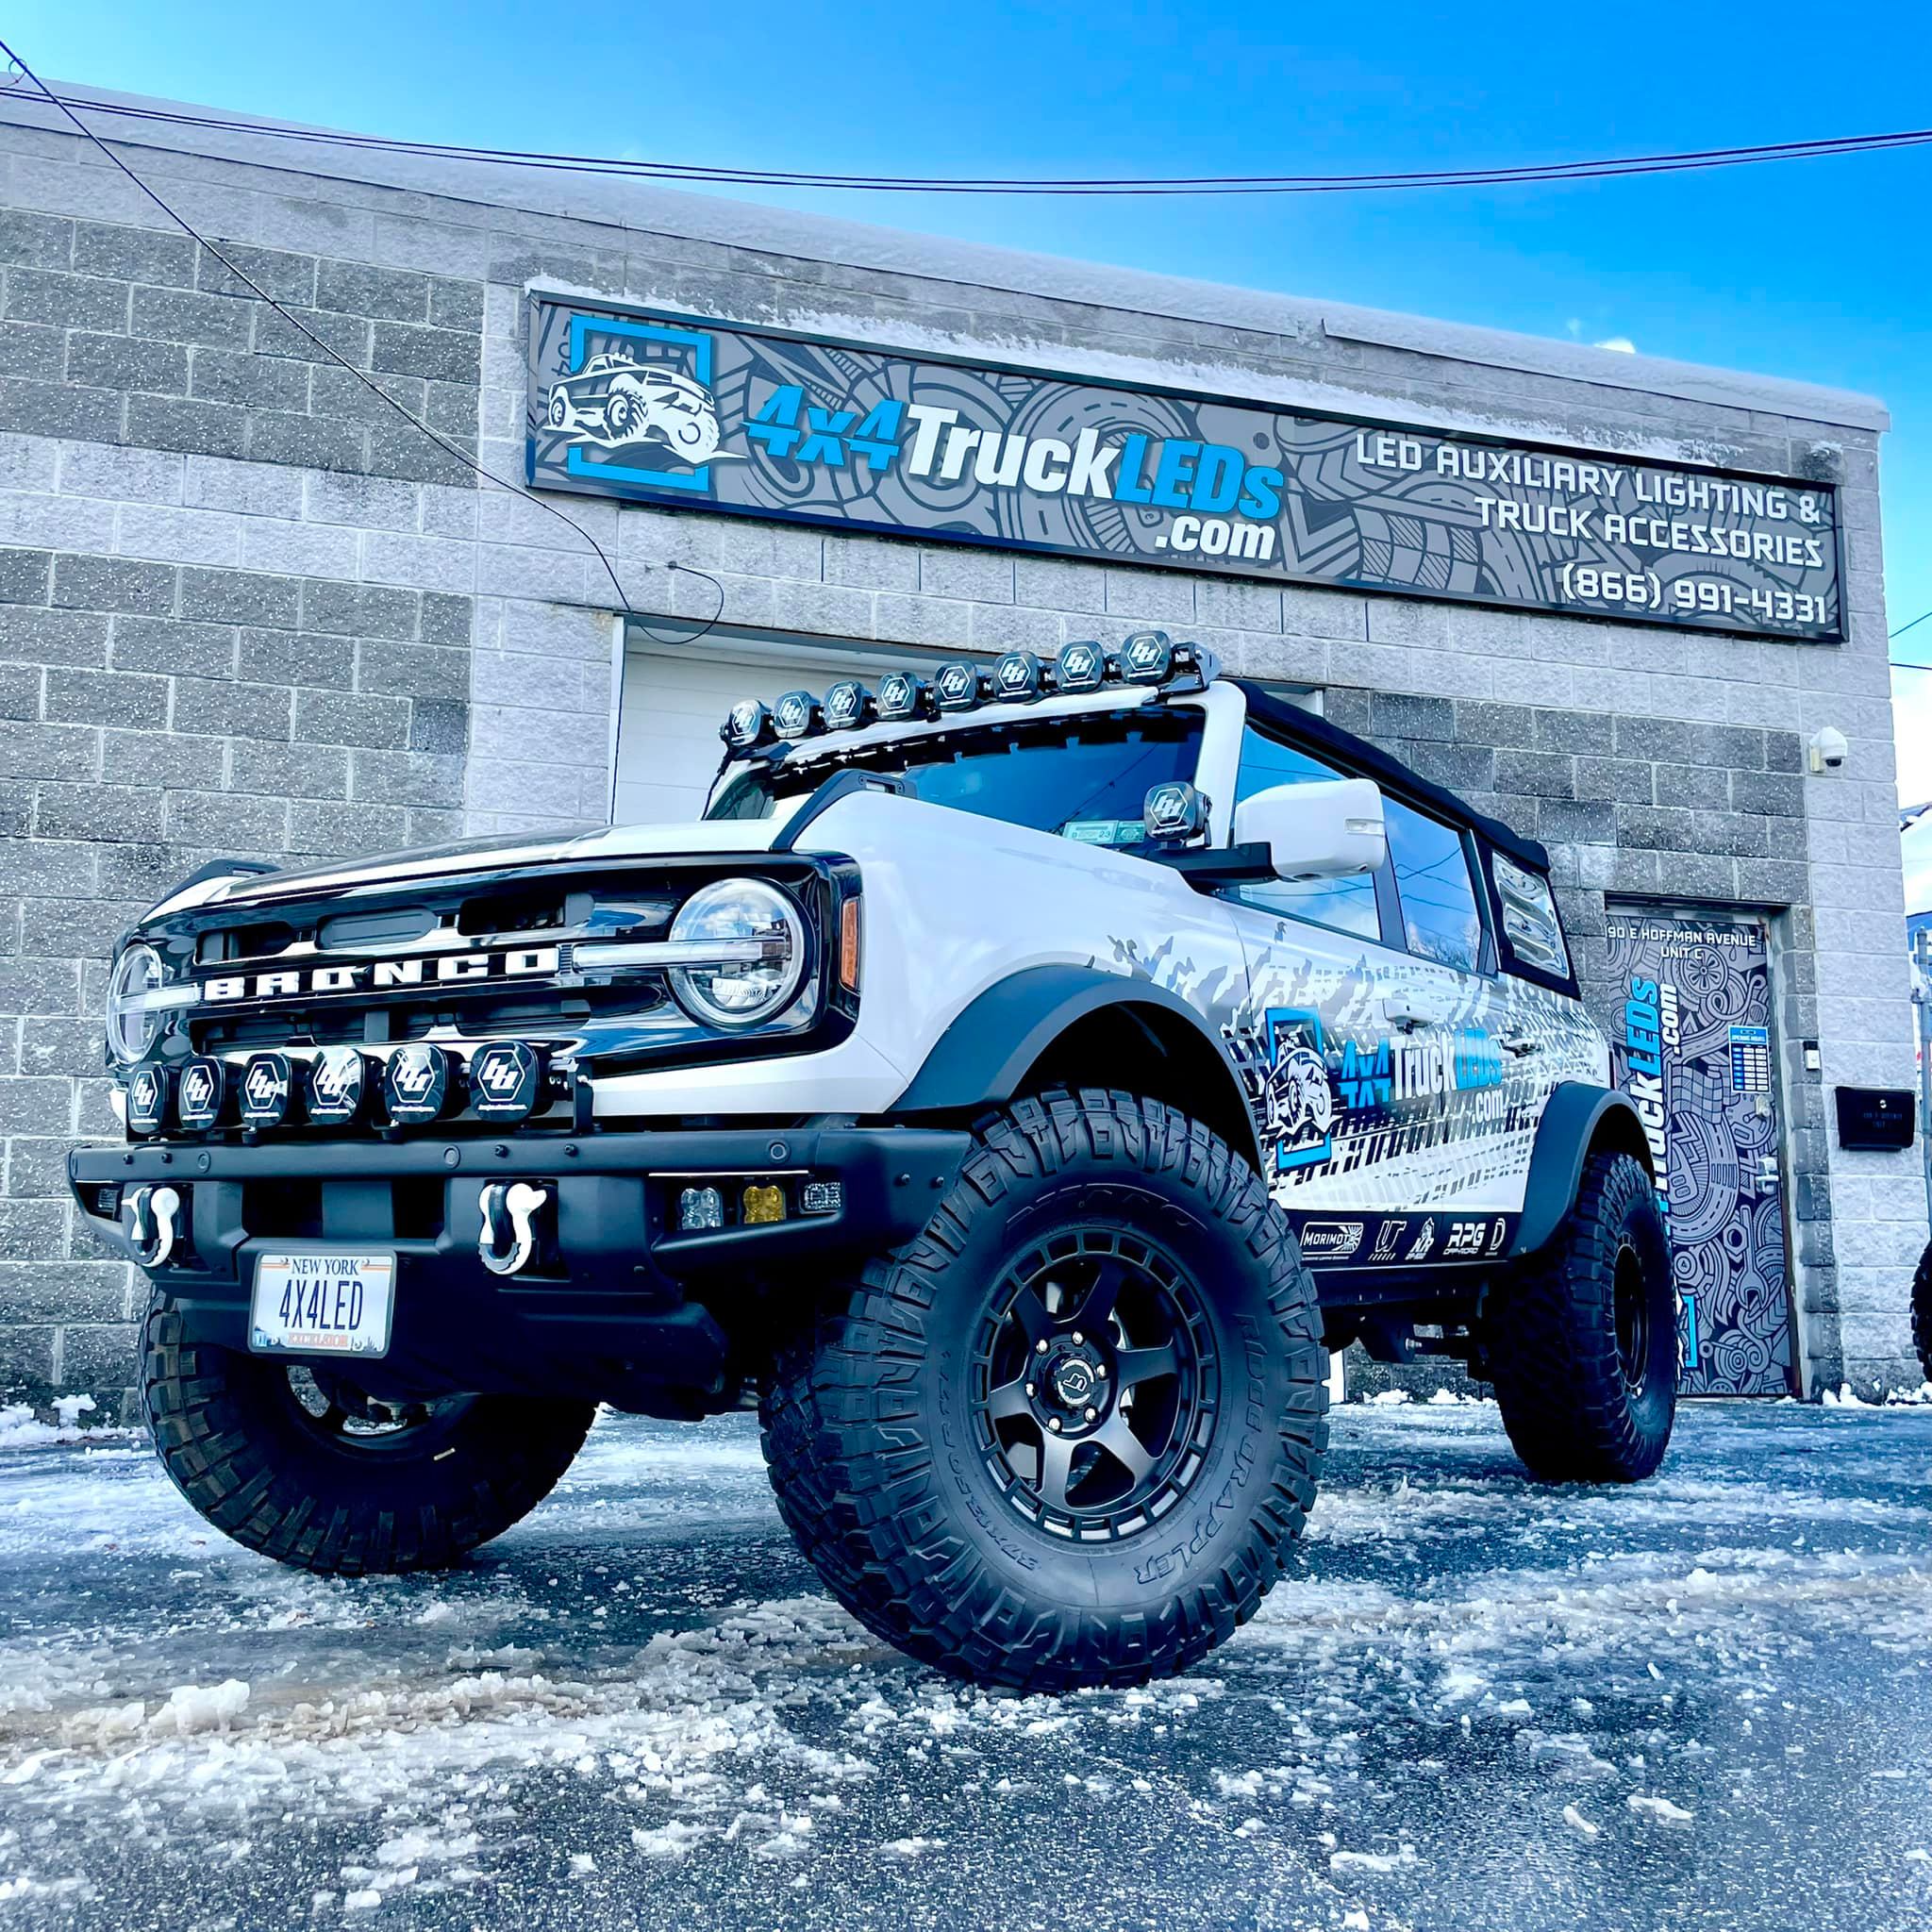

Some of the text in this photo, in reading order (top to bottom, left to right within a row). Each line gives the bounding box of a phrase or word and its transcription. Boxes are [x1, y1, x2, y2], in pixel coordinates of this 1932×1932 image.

[1357, 434, 1822, 525] LED AUXILIARY LIGHTING &
[1154, 514, 1275, 561] .com
[1474, 496, 1824, 568] TRUCK ACCESSORIES
[1562, 563, 1826, 625] (866) 991-4331
[1630, 927, 1638, 940] E
[1641, 928, 1703, 943] HOFFMAN
[1706, 932, 1757, 946] AVENUE
[1660, 946, 1691, 959] UNIT
[204, 946, 560, 1002] BRONCO
[1659, 983, 1680, 1055] .com
[291, 1257, 359, 1275] NEW YORK
[279, 1279, 363, 1330] 4X4LED
